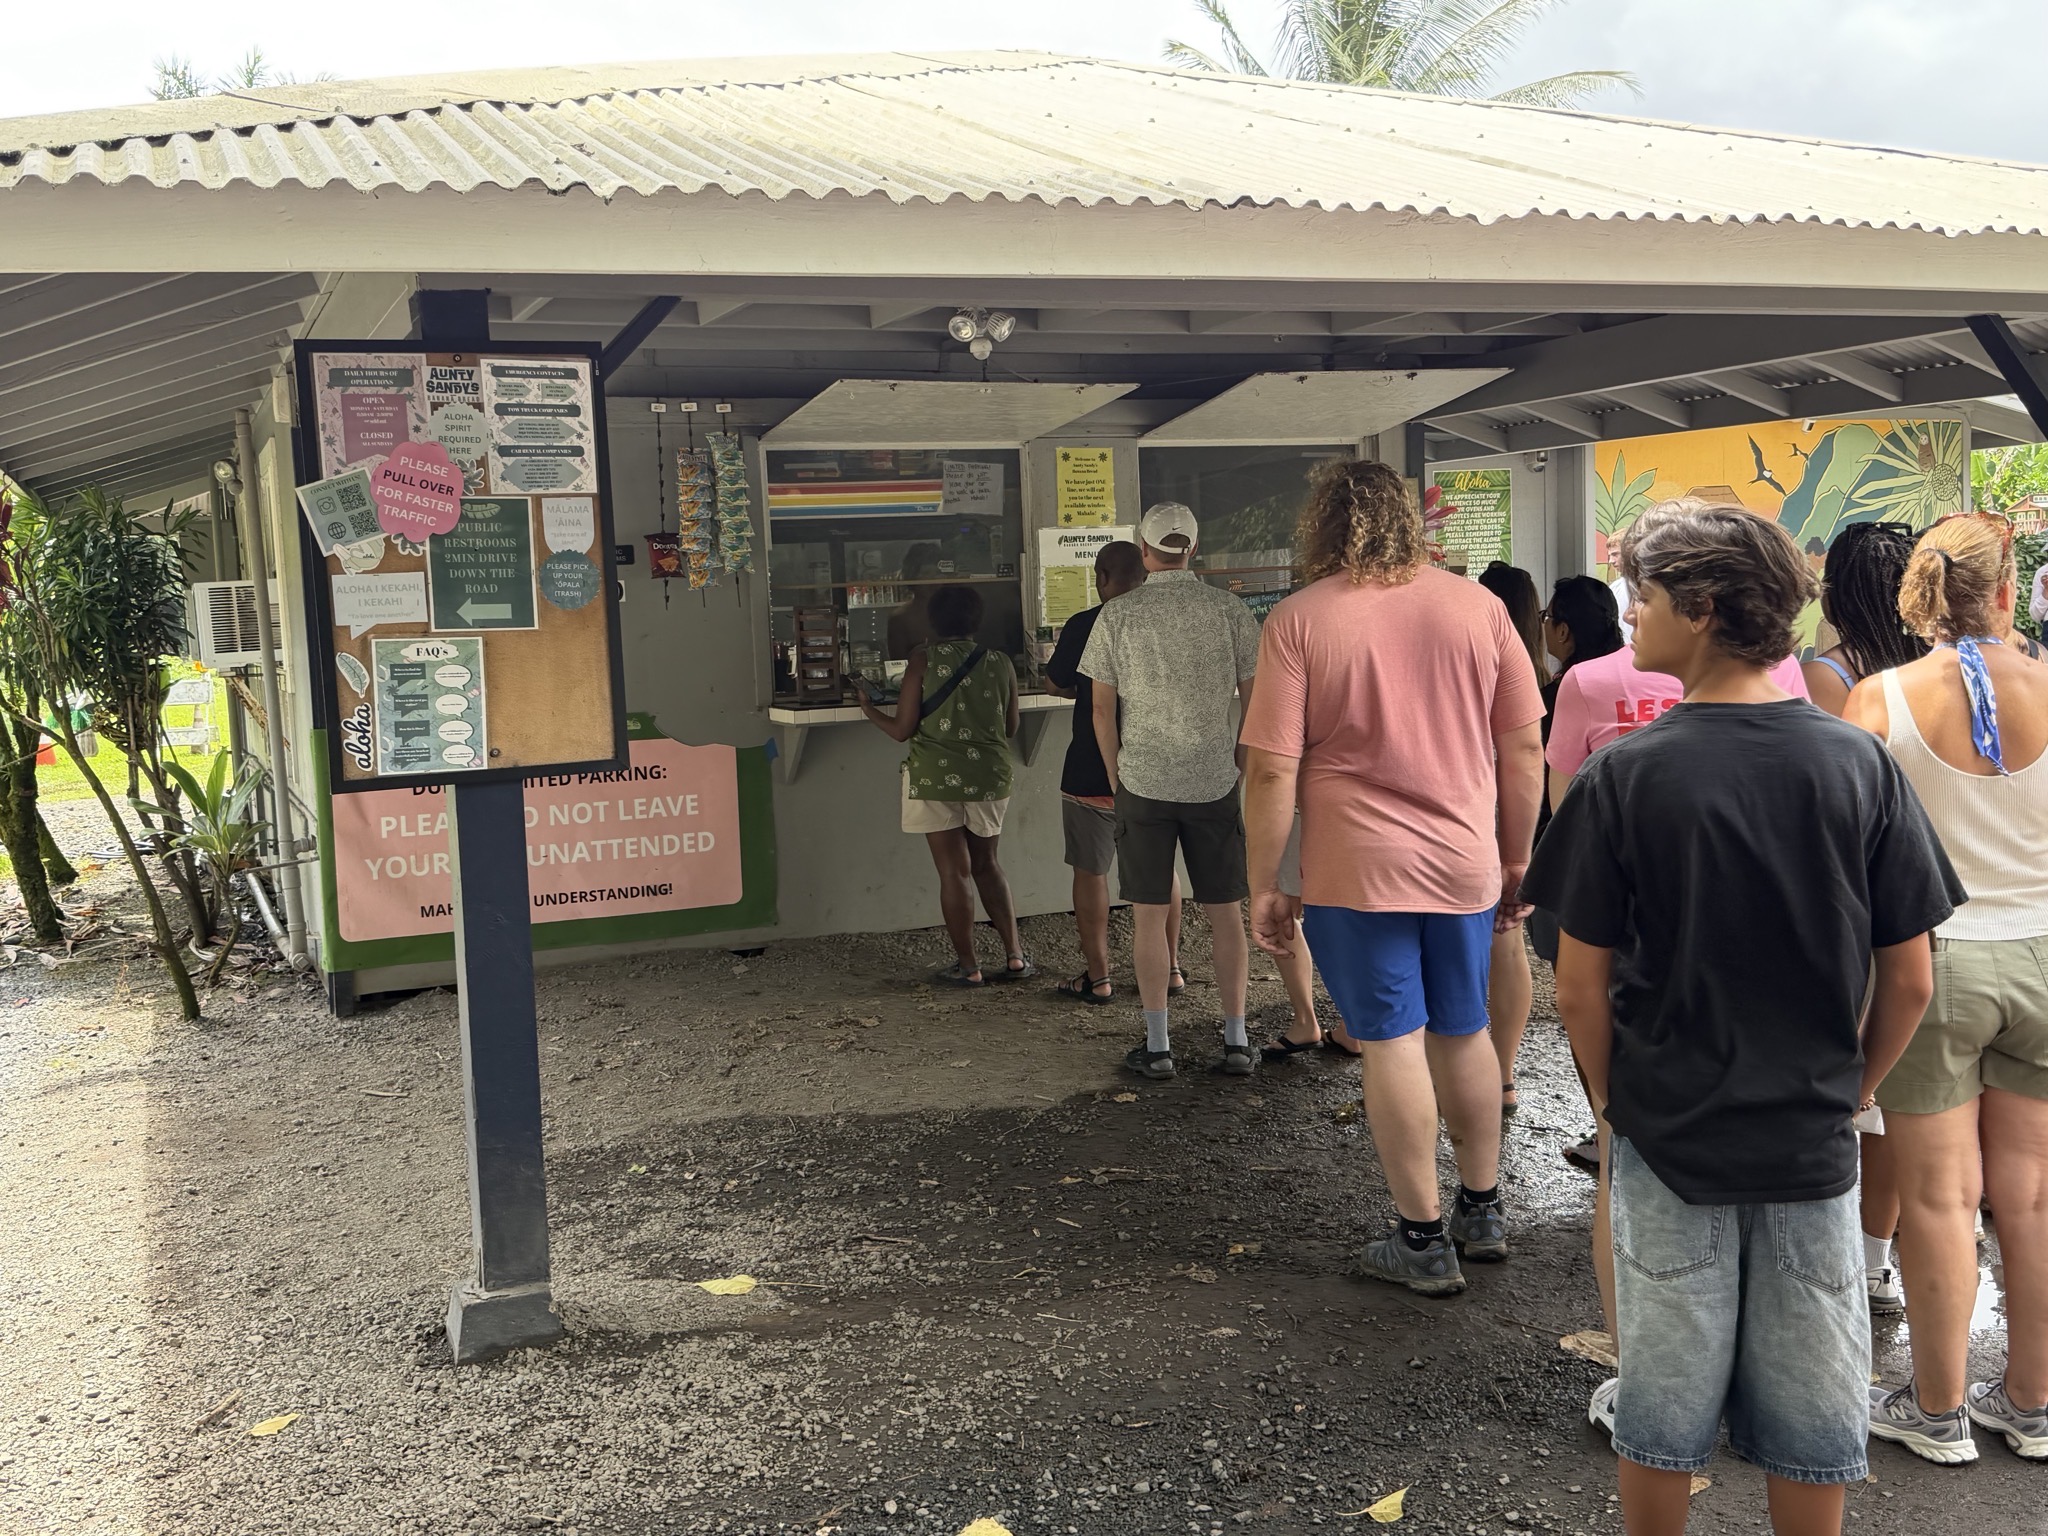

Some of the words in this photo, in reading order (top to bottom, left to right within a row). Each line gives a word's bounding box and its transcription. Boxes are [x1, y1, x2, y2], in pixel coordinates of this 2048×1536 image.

[430, 368, 474, 380] AUNTY
[400, 456, 448, 478] PLEASE
[383, 470, 415, 487] PULL
[420, 479, 454, 496] OVER
[1455, 471, 1491, 491] Aloha
[376, 486, 403, 500] FOR
[406, 493, 453, 514] FASTER
[384, 505, 436, 526] TRAFFIC
[457, 523, 502, 532] PUBLIC
[444, 538, 517, 547] RESTROOMS
[445, 554, 475, 562] 2MIN
[480, 554, 517, 562] DRIVE
[449, 569, 486, 578] DOWN
[490, 569, 515, 578] THE
[336, 585, 372, 594] ALOHA
[465, 584, 498, 593] ROAD
[364, 598, 402, 606] KEKAHI
[343, 704, 371, 768] aloha
[578, 765, 667, 784] PARKING:
[380, 812, 449, 839] PLEA
[550, 801, 610, 826] NOT
[618, 794, 699, 821] LEAVE
[365, 853, 451, 880] YOUR
[527, 832, 715, 866] UNATTENDED
[534, 883, 673, 906] UNDERSTANDING!
